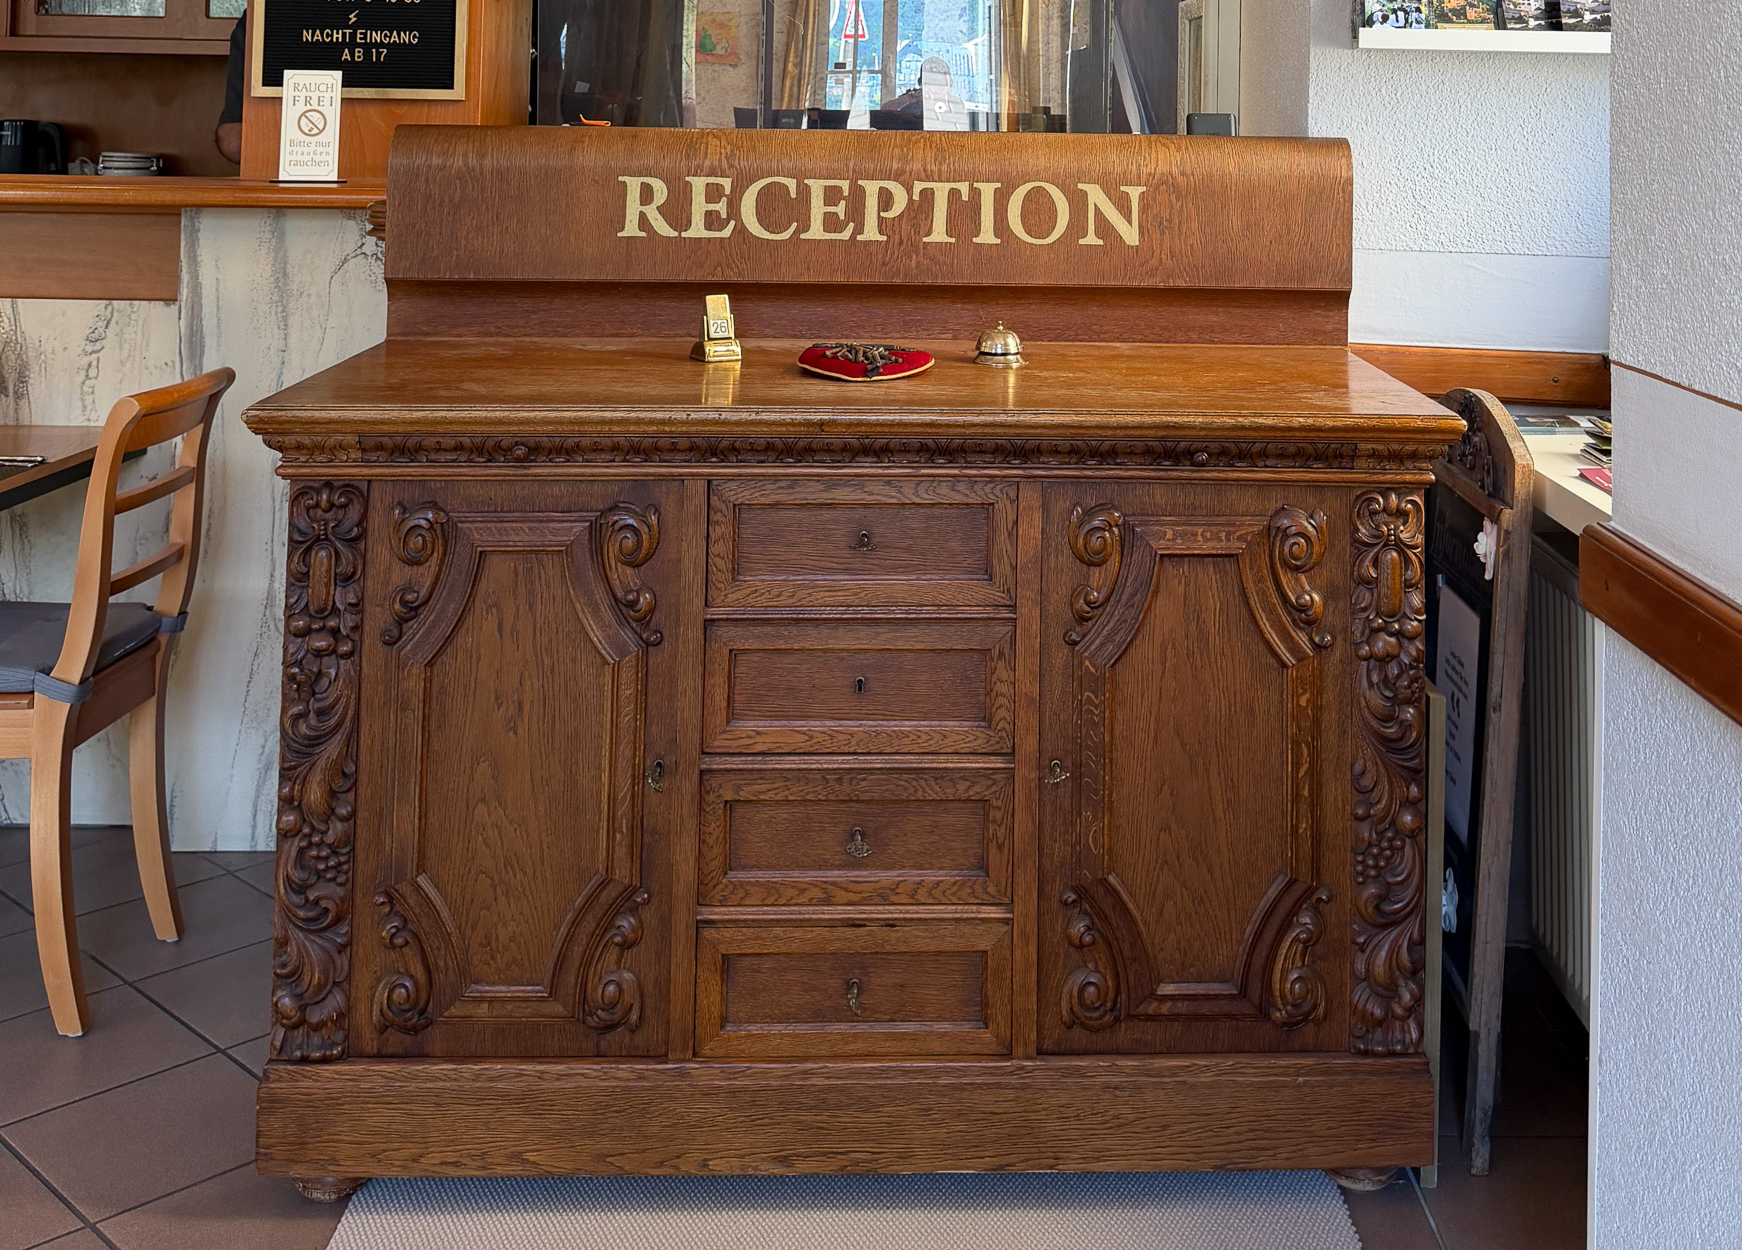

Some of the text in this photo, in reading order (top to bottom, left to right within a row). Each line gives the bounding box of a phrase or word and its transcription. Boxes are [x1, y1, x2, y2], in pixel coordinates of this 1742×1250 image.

[302, 28, 419, 45] NACHT EINGANG
[341, 48, 388, 62] AB 17
[293, 82, 334, 93] RAUCH
[292, 95, 334, 107] FREI
[289, 139, 332, 148] Bitte nur
[288, 157, 330, 167] rauchen
[617, 175, 1147, 246] RECEPTION
[712, 321, 727, 334] 26
